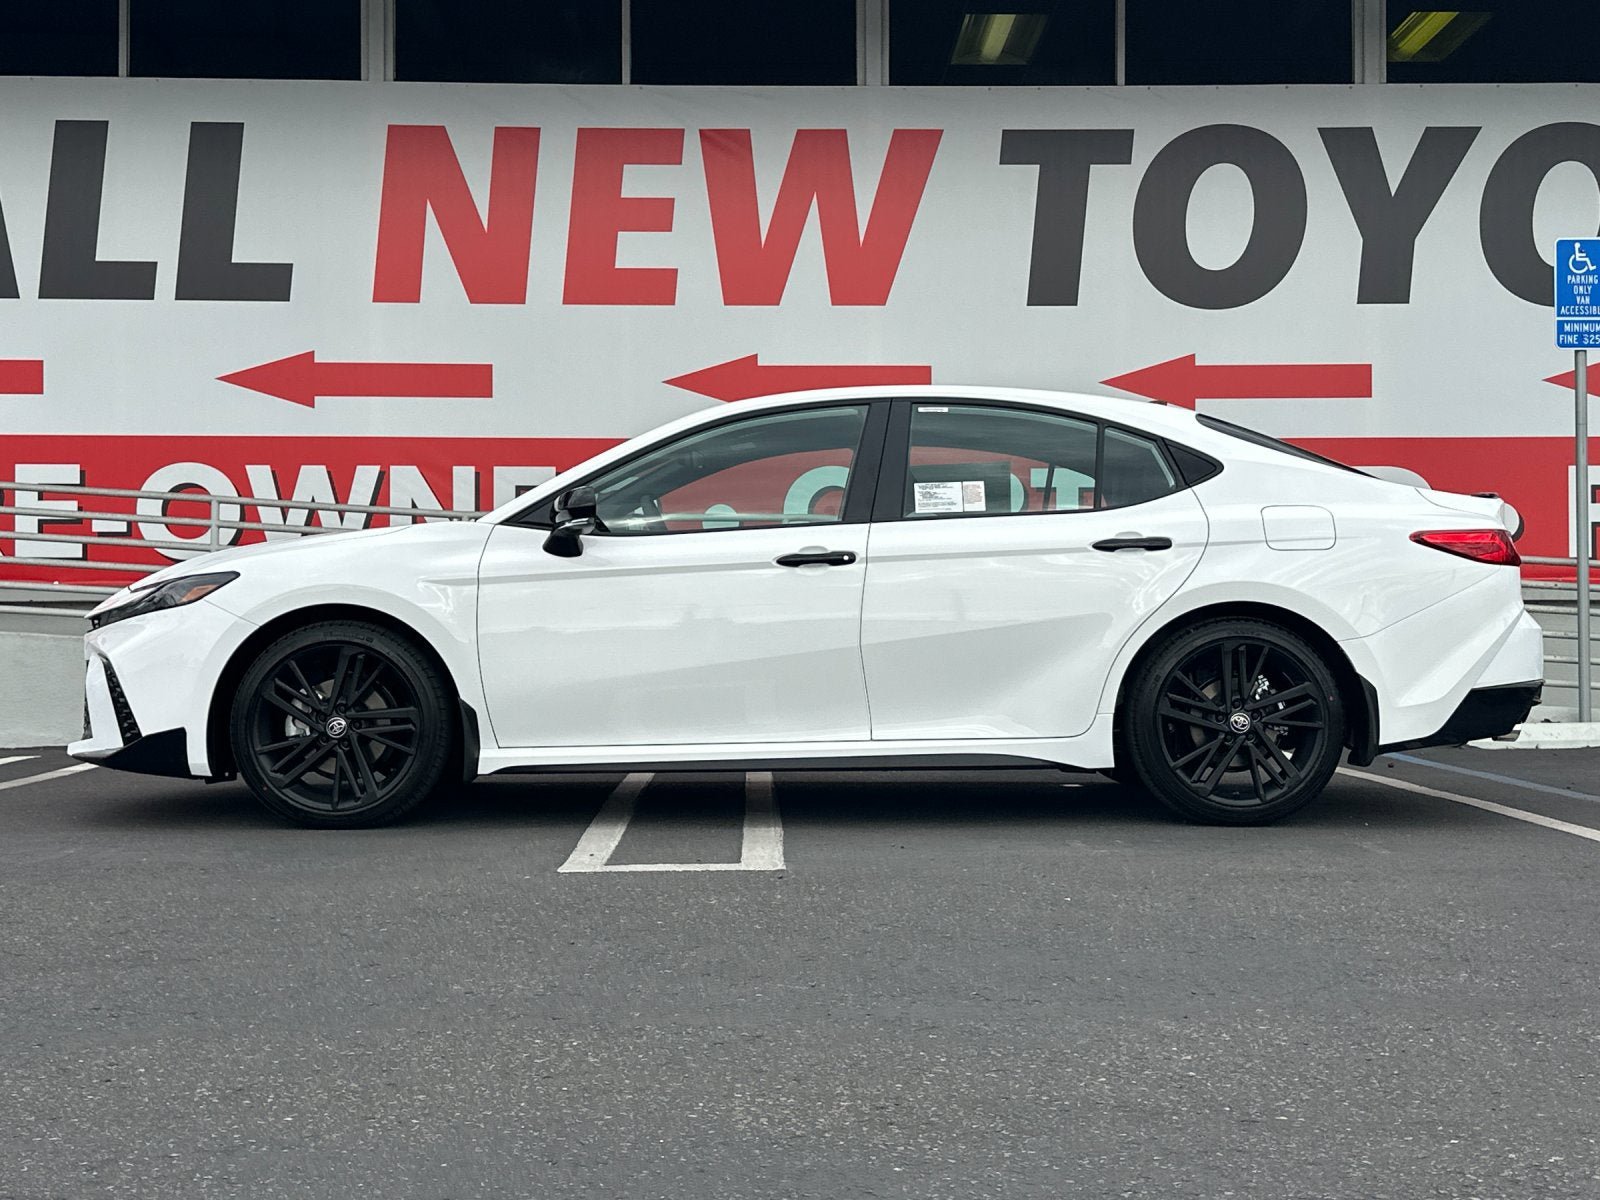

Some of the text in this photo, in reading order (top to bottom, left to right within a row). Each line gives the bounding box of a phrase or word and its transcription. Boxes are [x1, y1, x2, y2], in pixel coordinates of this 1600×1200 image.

[0, 119, 1600, 311] LL NEW TOYO
[1567, 274, 1599, 285] PARKING
[1573, 285, 1592, 295] ONLY
[1576, 295, 1590, 305] VAN
[1563, 322, 1600, 333] MINIMUM
[1559, 334, 1579, 345] FINE
[0, 461, 564, 564] E-OWN
